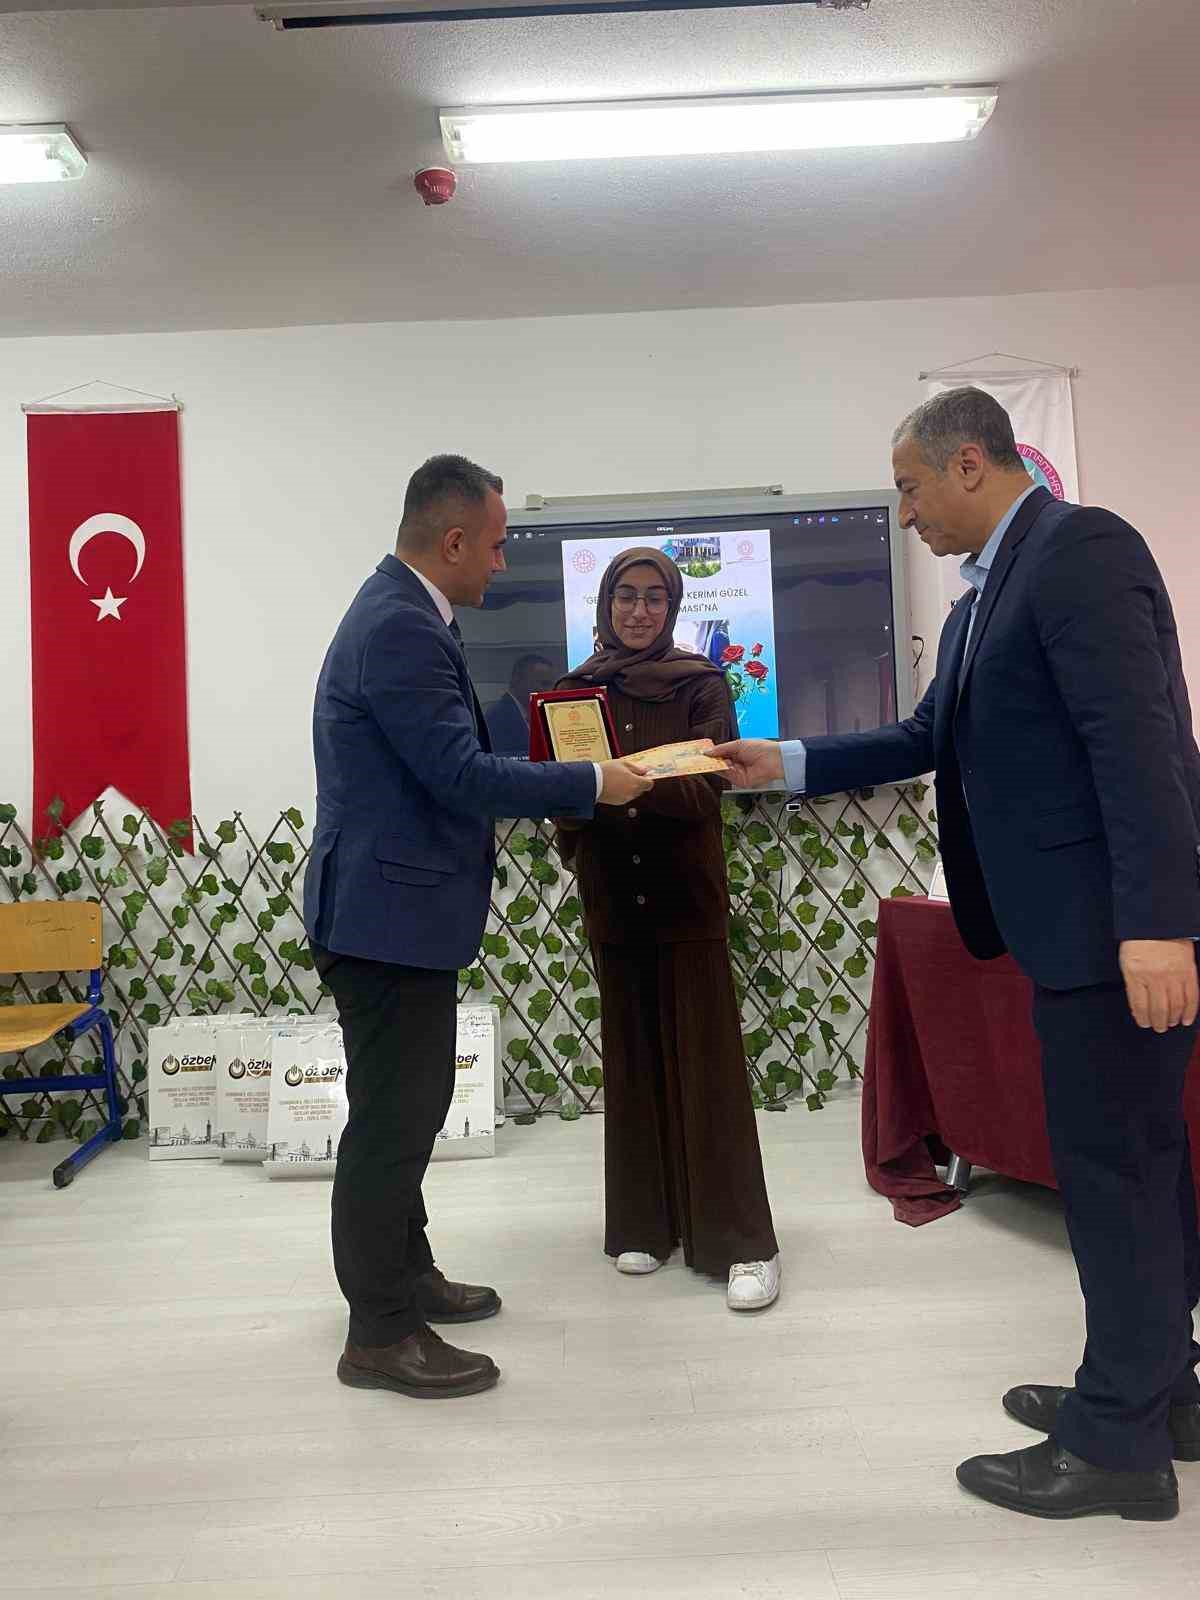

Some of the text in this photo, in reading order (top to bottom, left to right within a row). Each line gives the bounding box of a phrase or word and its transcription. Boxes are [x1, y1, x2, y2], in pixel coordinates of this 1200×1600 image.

[1049, 473, 1063, 498] HAT
[719, 587, 749, 598] GÜZEL
[247, 1058, 272, 1070] özb
[456, 1053, 480, 1069] bek
